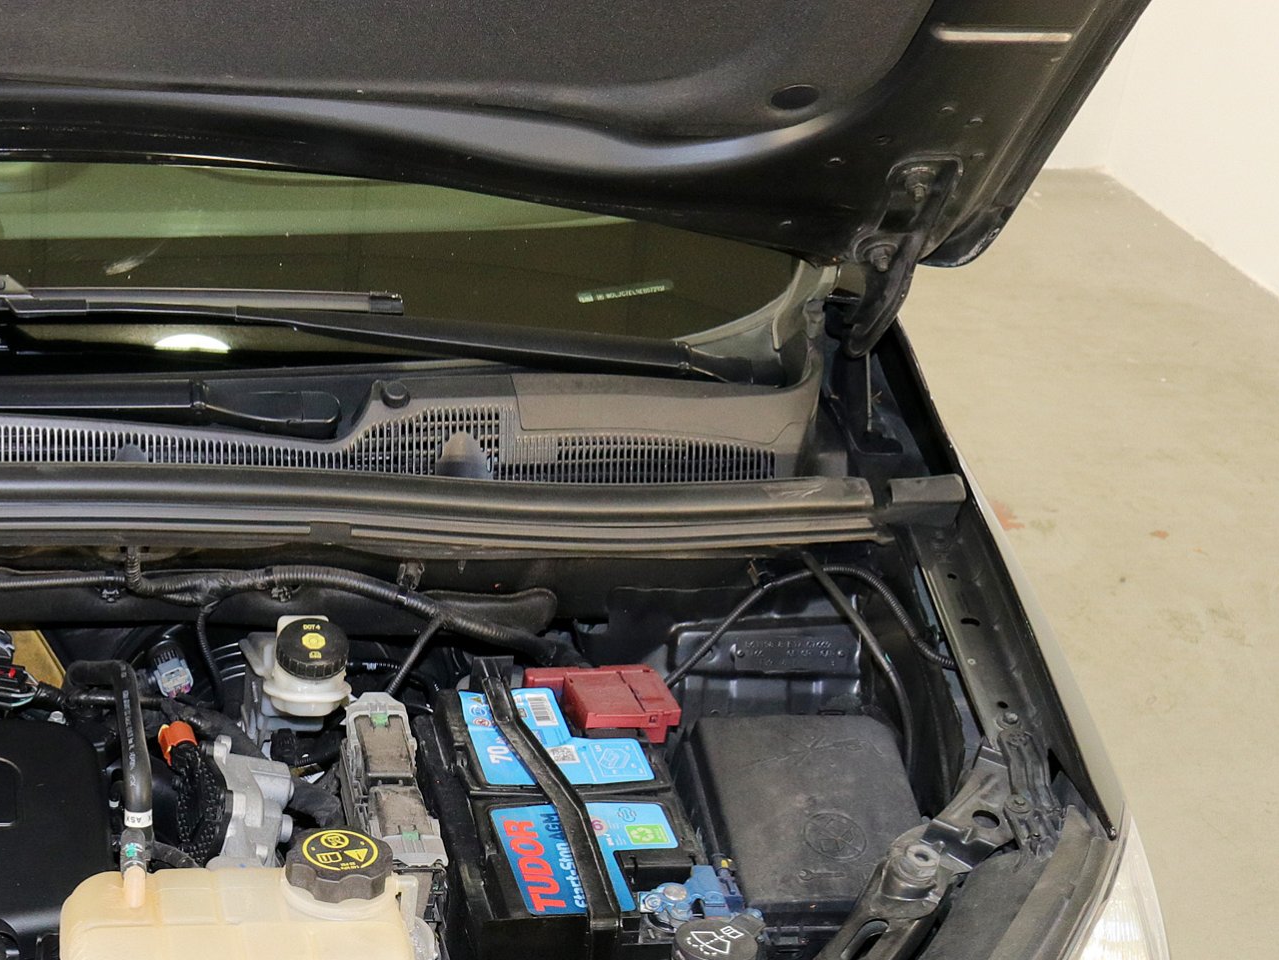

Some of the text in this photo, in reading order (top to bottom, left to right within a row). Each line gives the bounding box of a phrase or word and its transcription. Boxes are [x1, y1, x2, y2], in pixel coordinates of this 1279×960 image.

[487, 745, 513, 764] 70
[540, 813, 565, 840] AGM
[503, 819, 566, 912] TUDOR
